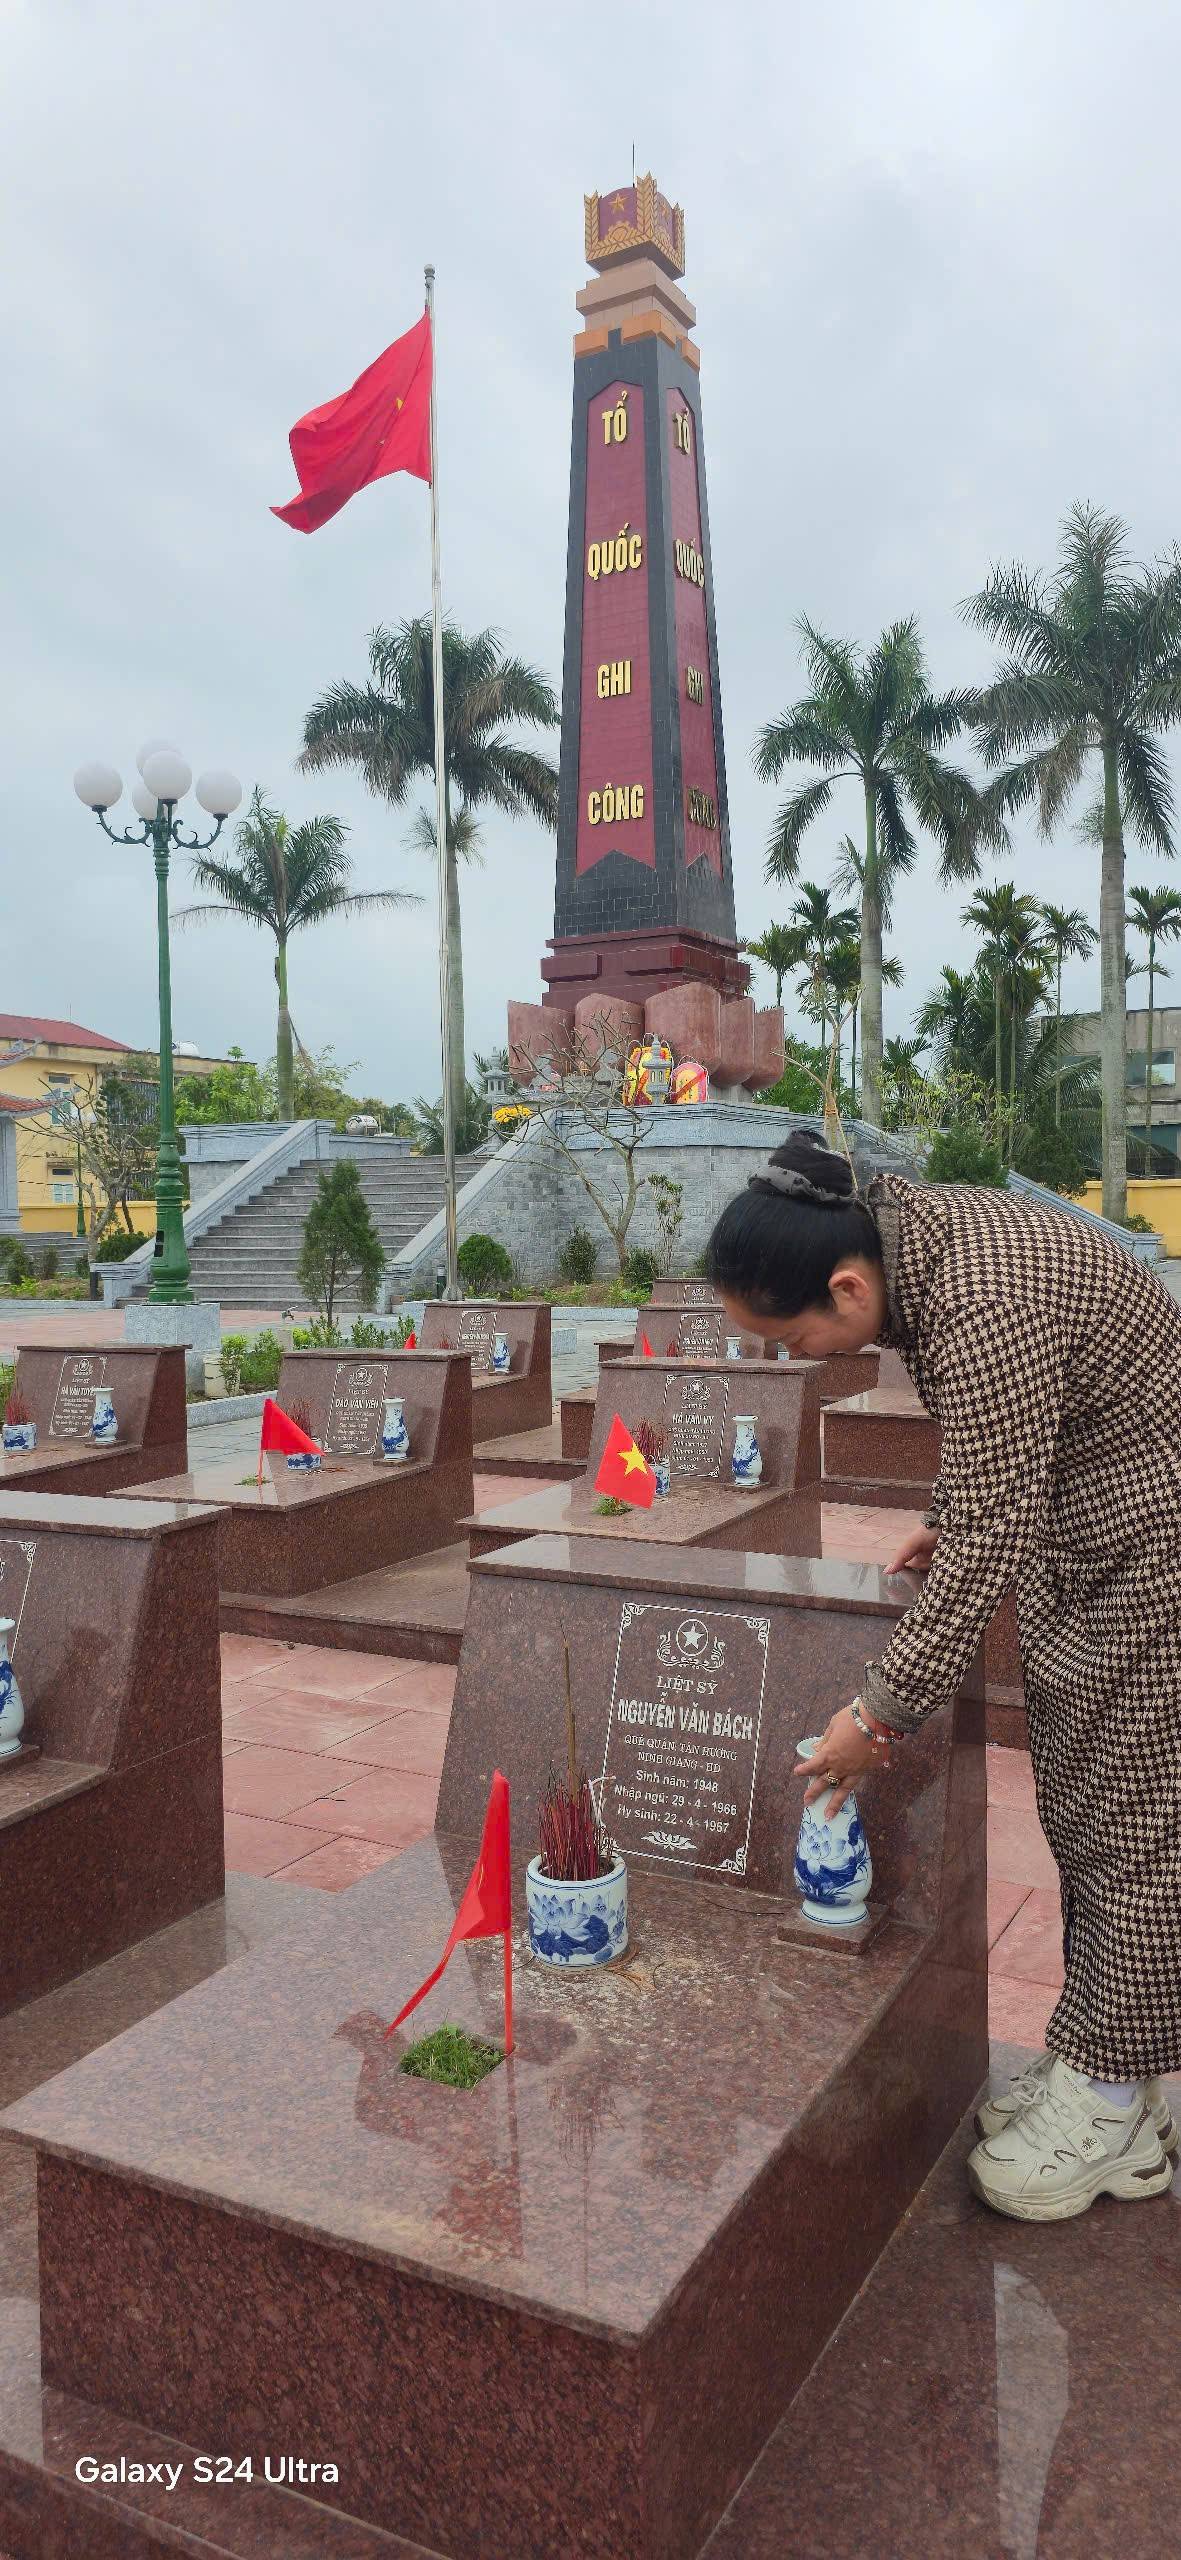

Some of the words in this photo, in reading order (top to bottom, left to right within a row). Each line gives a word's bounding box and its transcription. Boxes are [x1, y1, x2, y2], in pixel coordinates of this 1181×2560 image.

[602, 390, 628, 445] TỔ
[587, 522, 642, 581] QUỐC
[597, 660, 632, 699] GHI
[587, 782, 644, 825] CÔNG
[657, 1675, 694, 1694] LIỆT
[697, 1680, 718, 1695] SỸ
[617, 1692, 676, 1729] NGUYỄN
[680, 1702, 710, 1735] VĂN
[712, 1707, 753, 1741] BÁCH
[638, 1752, 663, 1764] NINH
[665, 1755, 698, 1770] GIANG
[636, 1769, 660, 1784] Sinh
[662, 1775, 690, 1788] năm:
[693, 1779, 719, 1793] 1948
[614, 1784, 642, 1801] Nhập
[672, 1794, 685, 1806] 29
[712, 1801, 737, 1816] 1966
[617, 1803, 632, 1819] Hy
[635, 1808, 661, 1822] sinh:
[664, 1812, 677, 1825] 22
[704, 1818, 730, 1834] 1967
